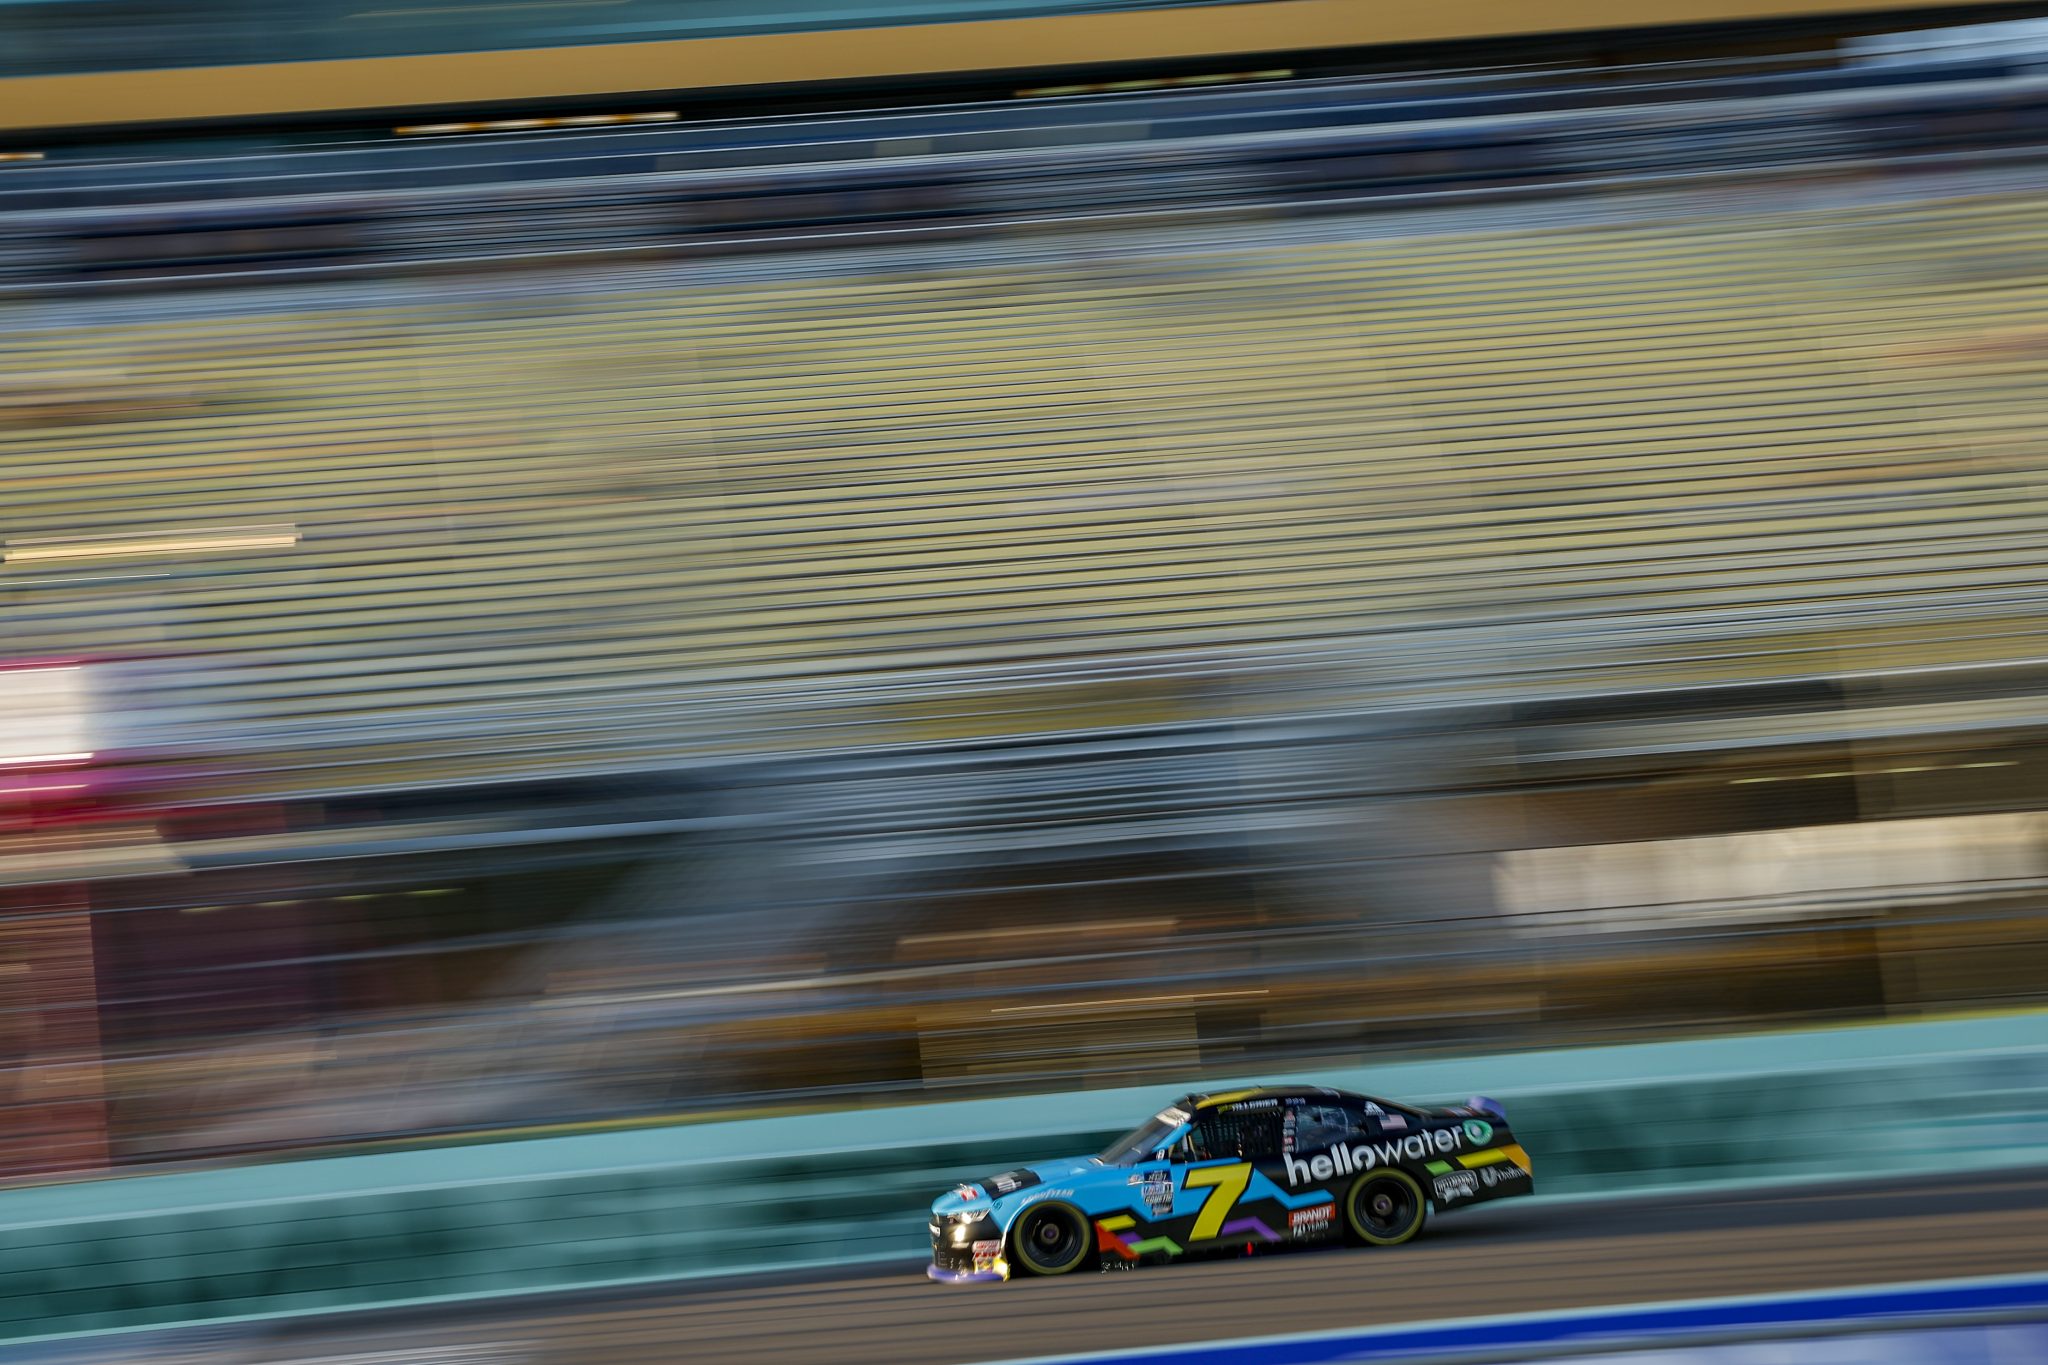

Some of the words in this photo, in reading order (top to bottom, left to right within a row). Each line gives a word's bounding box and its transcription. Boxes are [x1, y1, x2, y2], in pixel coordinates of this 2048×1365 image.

[1283, 1125, 1463, 1187] hellowater
[1185, 1161, 1252, 1242] 7
[1292, 1205, 1332, 1225] BRANDT
